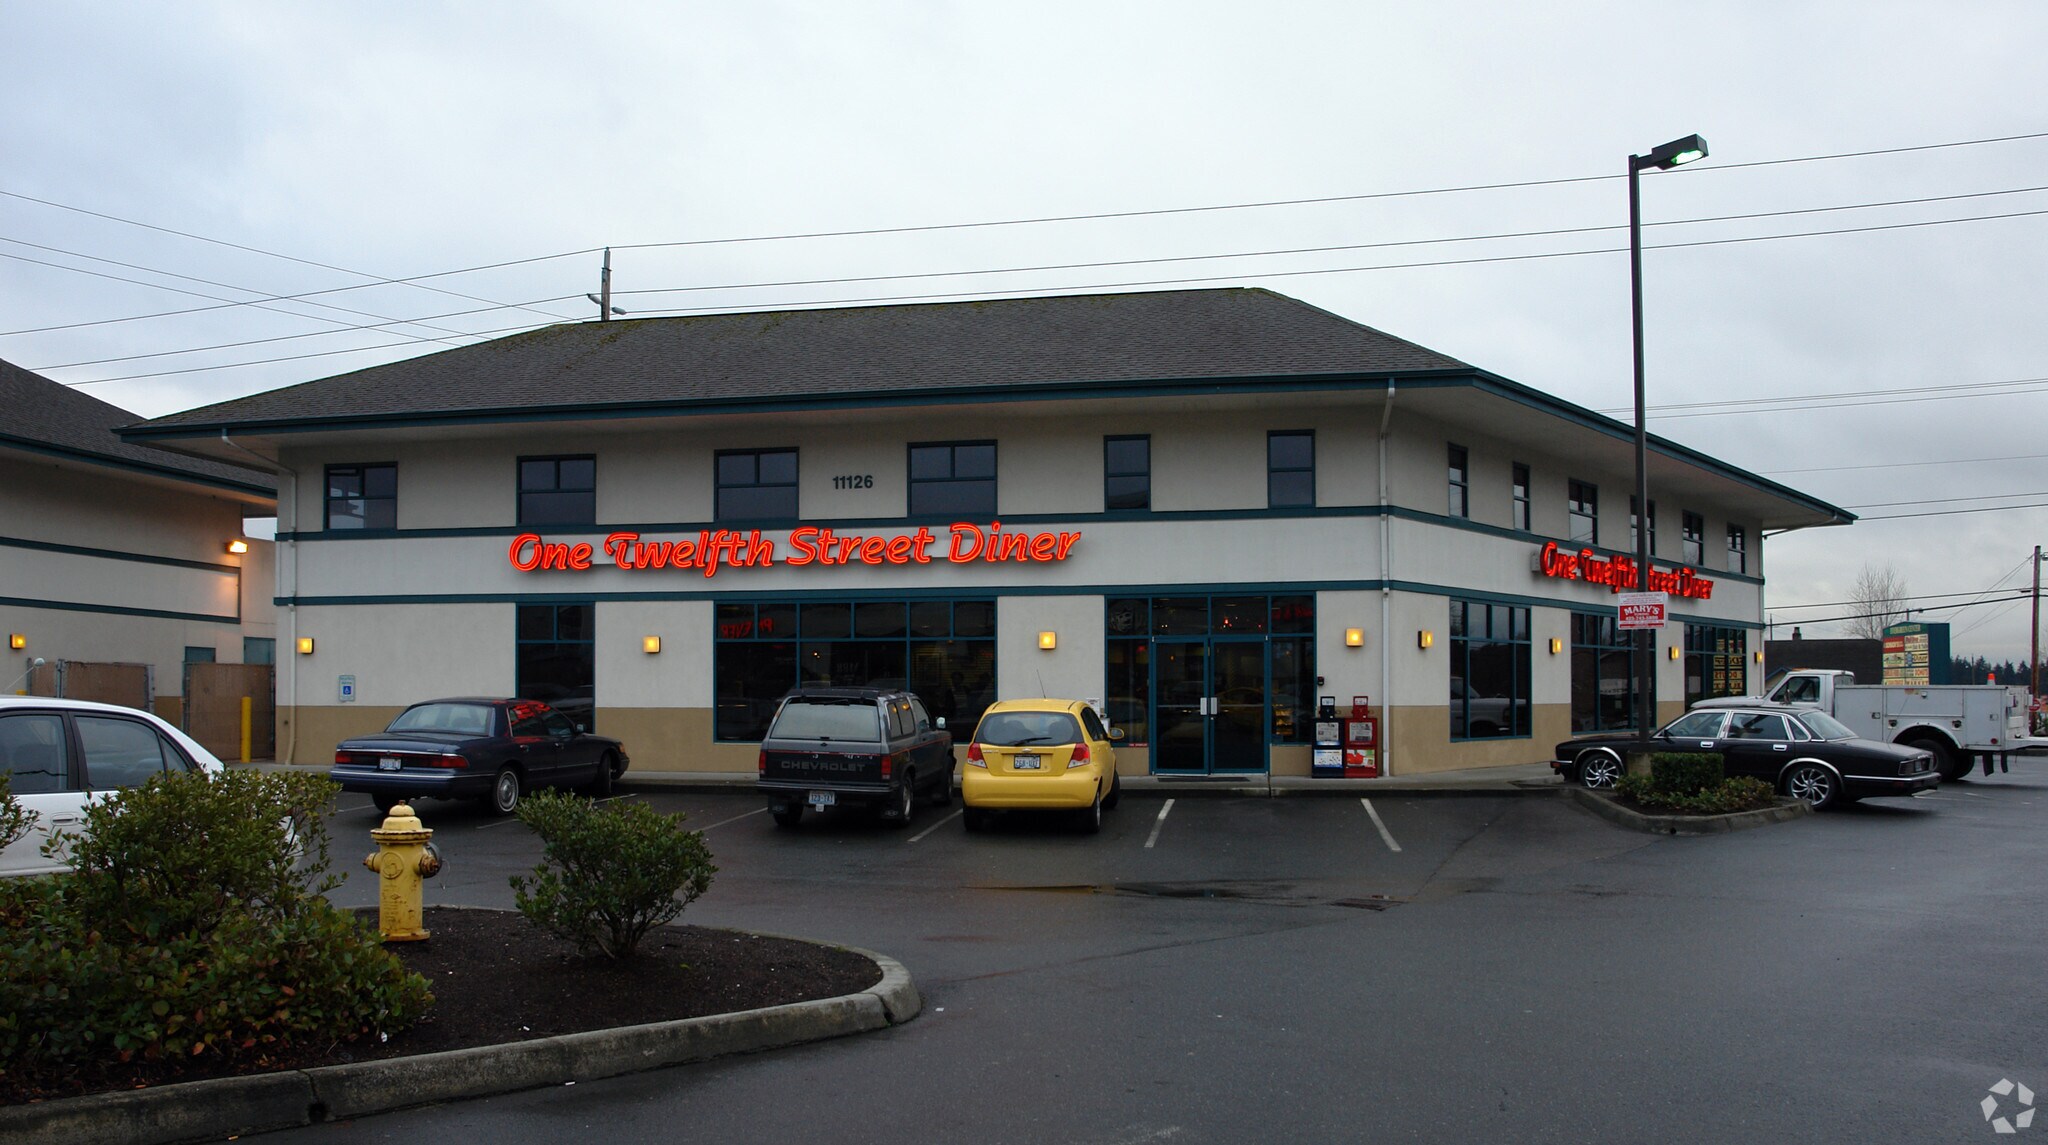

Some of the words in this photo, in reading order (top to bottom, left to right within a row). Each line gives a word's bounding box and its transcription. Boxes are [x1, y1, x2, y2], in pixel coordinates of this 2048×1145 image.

[832, 475, 874, 490] 11126
[509, 532, 593, 572] One
[604, 528, 775, 578] Twelfth
[786, 526, 936, 566] Street
[948, 520, 1082, 564] Diner
[1540, 541, 1578, 580] One
[1578, 548, 1639, 594] Twelfth
[1647, 563, 1680, 596] treet
[1680, 566, 1715, 600] Diner
[1624, 605, 1660, 616] MARY'S
[781, 760, 867, 772] CHEVROLET
